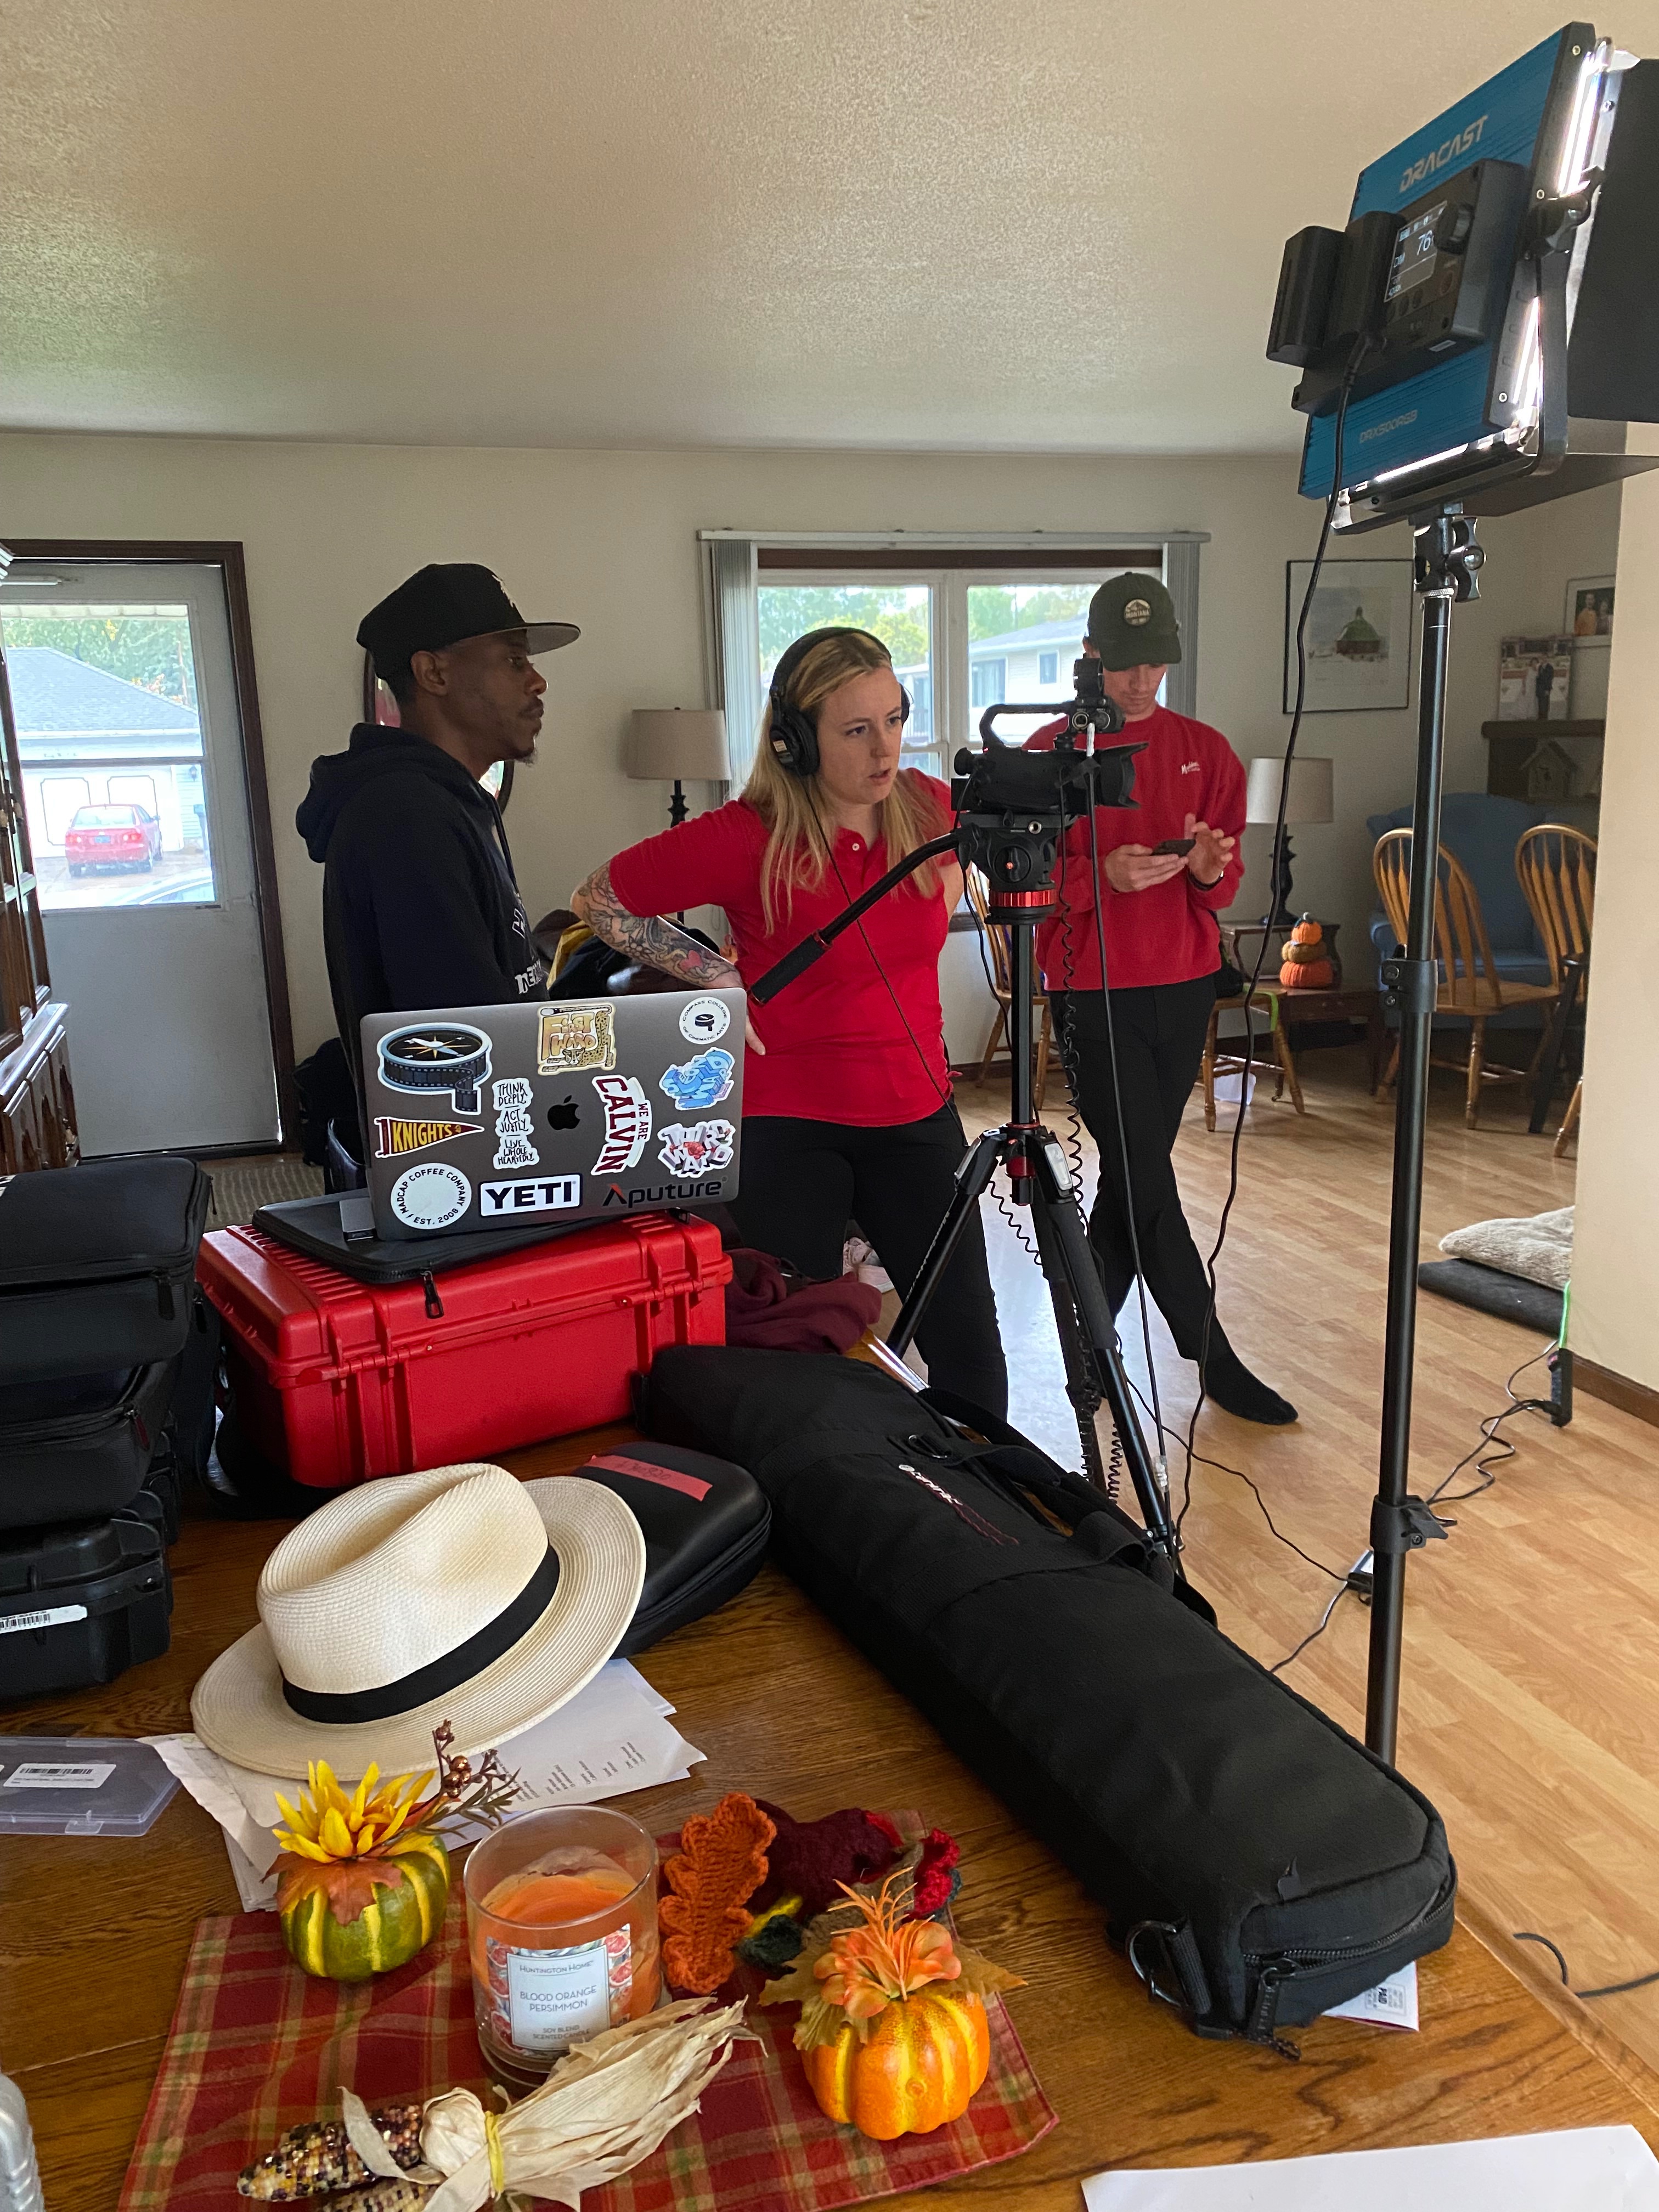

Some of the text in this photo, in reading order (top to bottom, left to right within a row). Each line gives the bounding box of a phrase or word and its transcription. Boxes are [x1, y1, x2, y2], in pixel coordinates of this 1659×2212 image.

[1400, 115, 1488, 193] DRACAST
[682, 1000, 727, 1022] COMPASS COLLEGE
[716, 1023, 726, 1036] ARTS
[550, 1033, 596, 1057] WARD
[497, 1082, 528, 1097] THINK
[499, 1093, 526, 1107] DEEPLY
[503, 1109, 521, 1124] ACT
[637, 1103, 649, 1140] WE ARE
[500, 1119, 528, 1133] JUSTLY
[596, 1078, 636, 1172] CALVIN
[392, 1122, 453, 1152] KNIGHTS
[505, 1139, 525, 1149] LIVE
[498, 1152, 534, 1165] HEARTEDLY
[504, 1147, 527, 1157] WHOLE
[397, 1168, 466, 1214] MADCAP COFFEE COMPANY
[485, 1181, 572, 1210] YETI
[603, 1180, 722, 1207] Aputure
[414, 1208, 459, 1225] EST. 2008
[519, 1961, 592, 1974] HUNTINGTON HOME
[520, 1985, 597, 2001] BLOOD ORANGE
[529, 1999, 588, 2012] PERSIMMON
